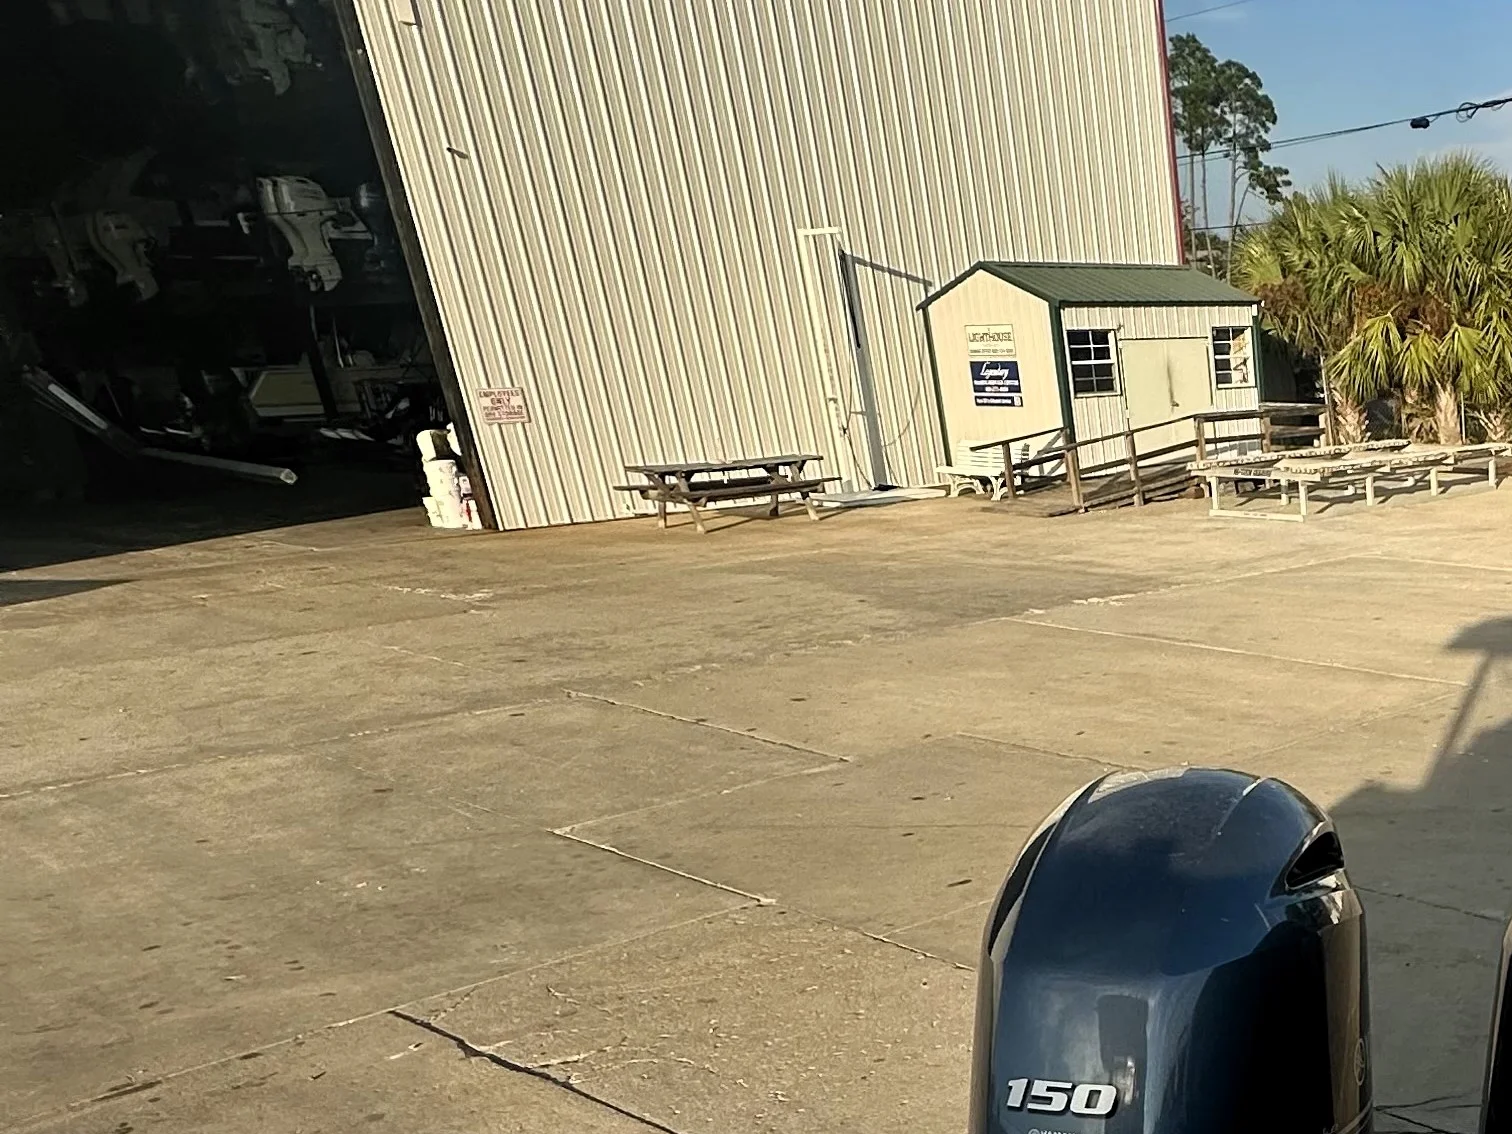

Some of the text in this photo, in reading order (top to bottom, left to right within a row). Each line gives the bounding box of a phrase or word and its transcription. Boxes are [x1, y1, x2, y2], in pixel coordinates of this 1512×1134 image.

[479, 390, 520, 398] EMPLOYEES
[490, 397, 511, 405] ONLY
[1007, 1078, 1118, 1115] 150
